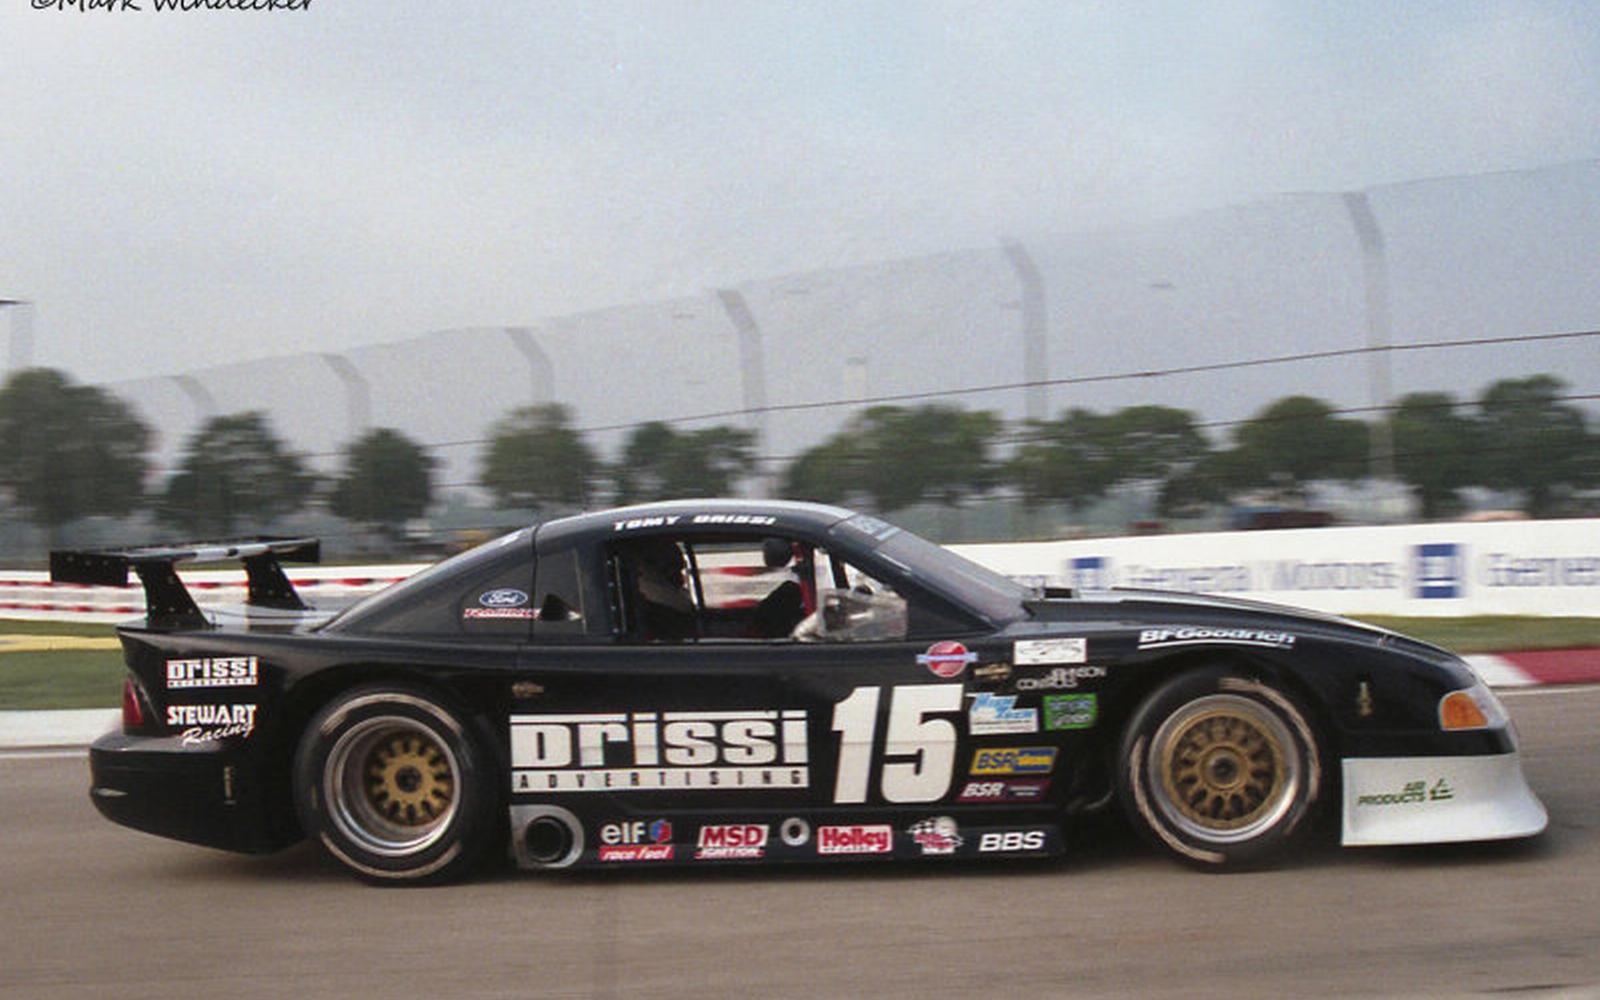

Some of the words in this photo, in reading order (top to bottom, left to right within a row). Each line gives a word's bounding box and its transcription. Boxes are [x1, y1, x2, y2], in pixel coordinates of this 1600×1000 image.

[614, 515, 681, 531] TOMY
[1138, 629, 1296, 643] BFGoodrich
[167, 704, 257, 726] STEWART
[181, 724, 256, 748] Racing
[832, 683, 964, 804] 15
[518, 769, 803, 790] ADVERTISING
[961, 783, 1005, 798] BSR
[1358, 791, 1426, 805] PRODUCTS
[600, 821, 646, 845] elf
[703, 826, 764, 847] MSD
[822, 828, 889, 852] Holley
[979, 831, 1046, 851] BBS
